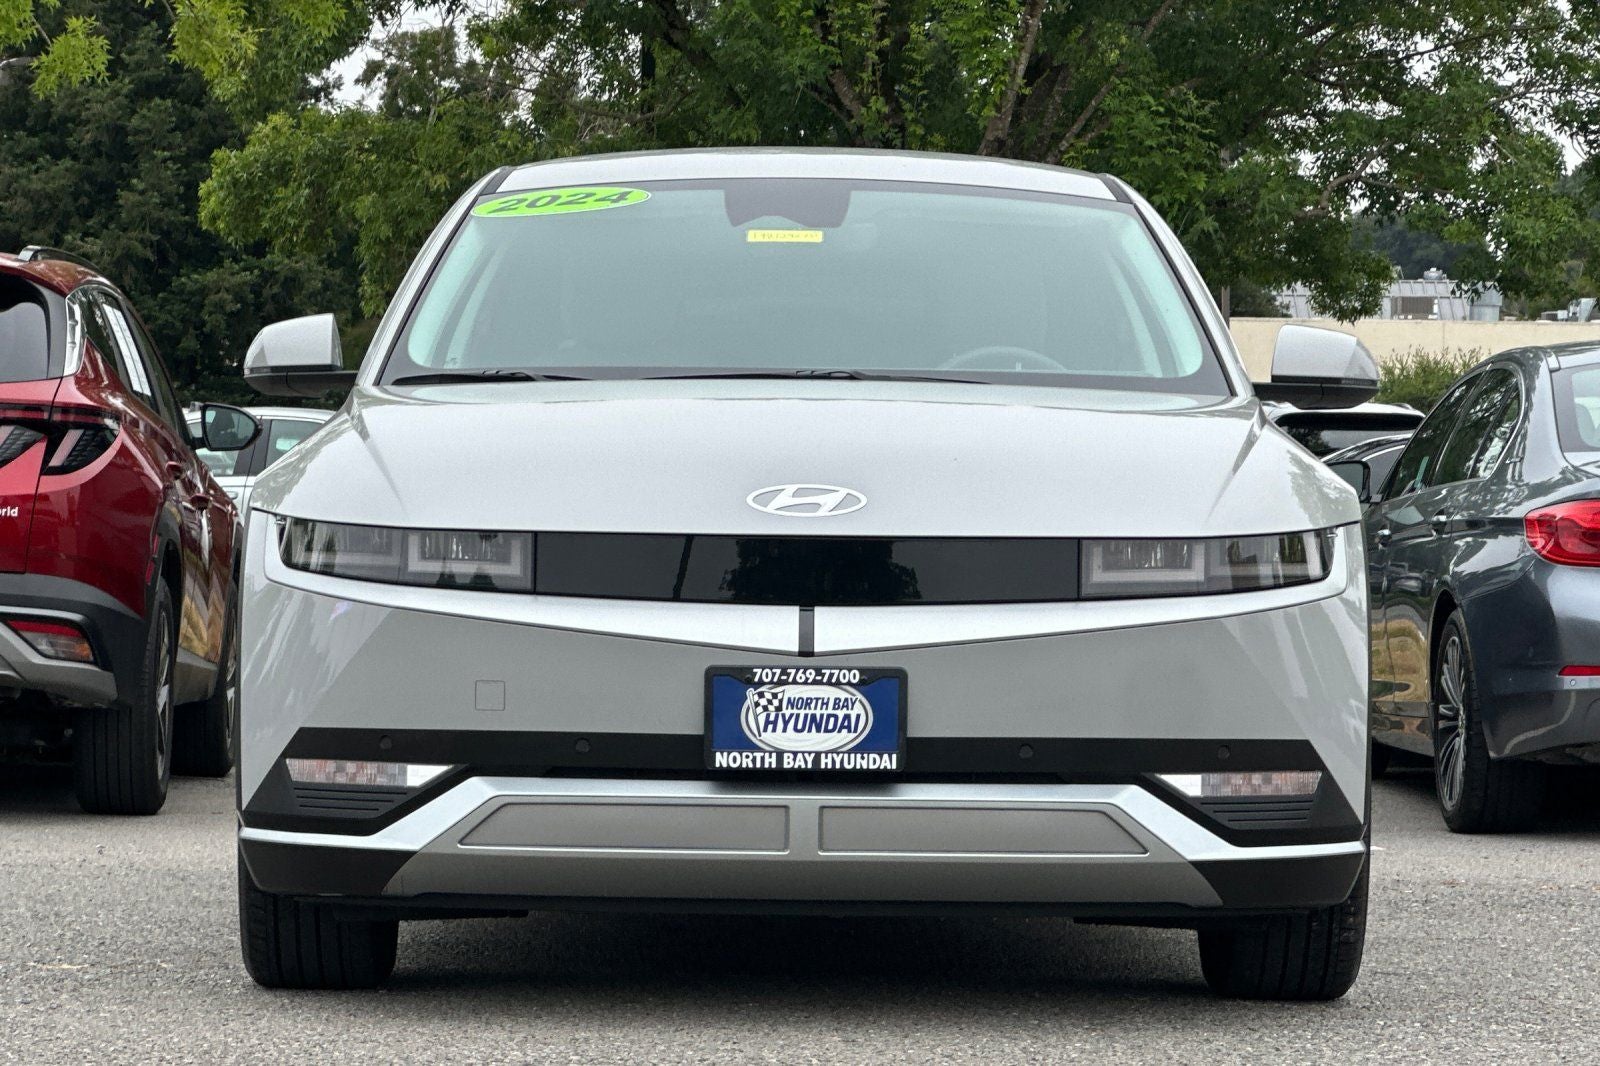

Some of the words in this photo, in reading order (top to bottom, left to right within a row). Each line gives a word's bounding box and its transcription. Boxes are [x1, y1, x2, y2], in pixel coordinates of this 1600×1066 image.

[487, 190, 634, 215] 2024
[0, 506, 19, 517] rid
[752, 668, 861, 684] 707-769-7700
[785, 697, 829, 711] NORTH
[832, 697, 860, 711] BAY
[762, 712, 862, 734] HYUNDAI
[715, 751, 777, 769] NORTH
[783, 752, 816, 769] BAY
[820, 752, 897, 770] HYUNDAI
